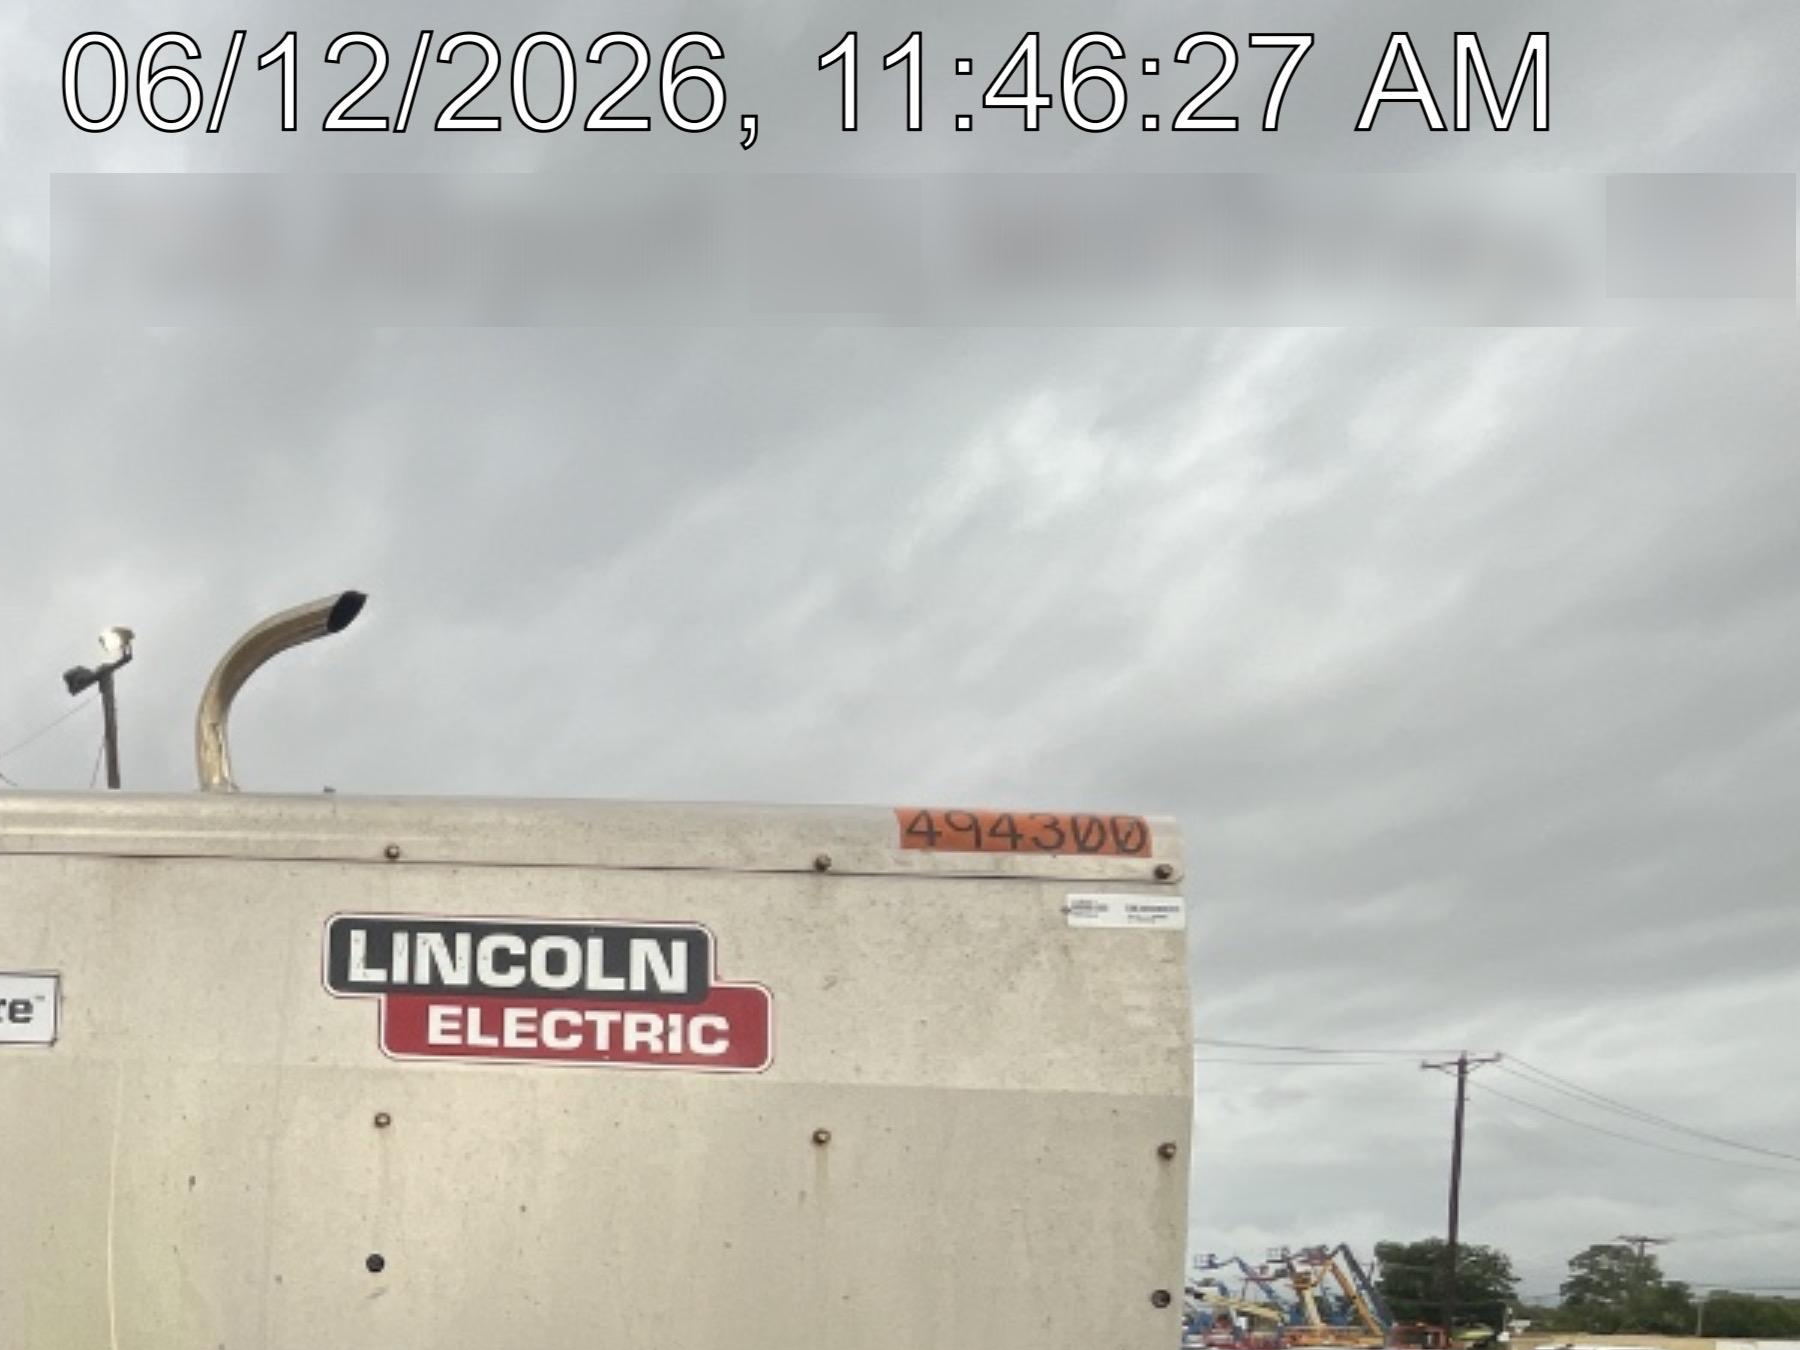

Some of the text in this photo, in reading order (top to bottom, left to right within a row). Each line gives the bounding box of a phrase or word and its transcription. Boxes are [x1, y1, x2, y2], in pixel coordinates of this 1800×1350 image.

[905, 809, 1149, 855] 494300
[348, 929, 688, 994] LINCOLN
[427, 1004, 730, 1055] ELECTRIC
